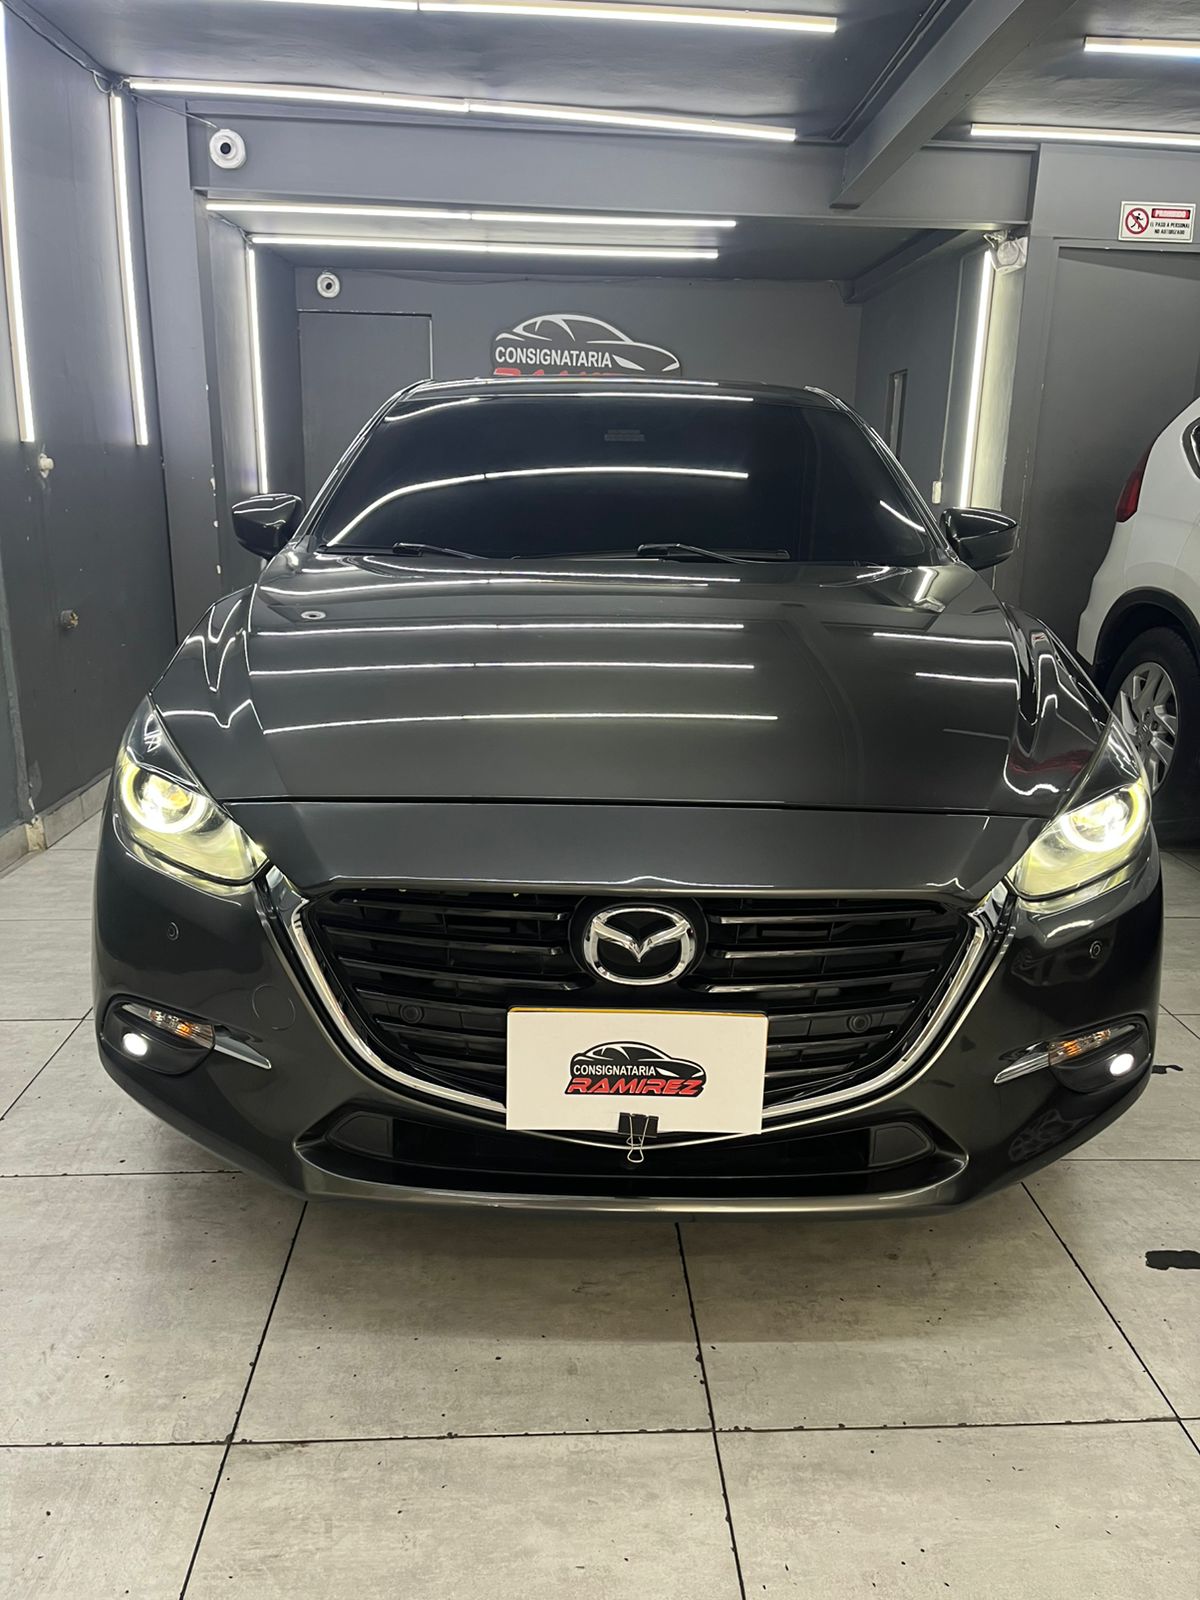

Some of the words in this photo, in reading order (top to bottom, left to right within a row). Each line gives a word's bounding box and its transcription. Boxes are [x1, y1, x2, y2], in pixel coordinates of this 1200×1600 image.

[495, 346, 612, 368] CONSIGNATARIA
[573, 1064, 656, 1076] CONSIGNATARIA
[567, 1077, 702, 1094] RAMIREZ
